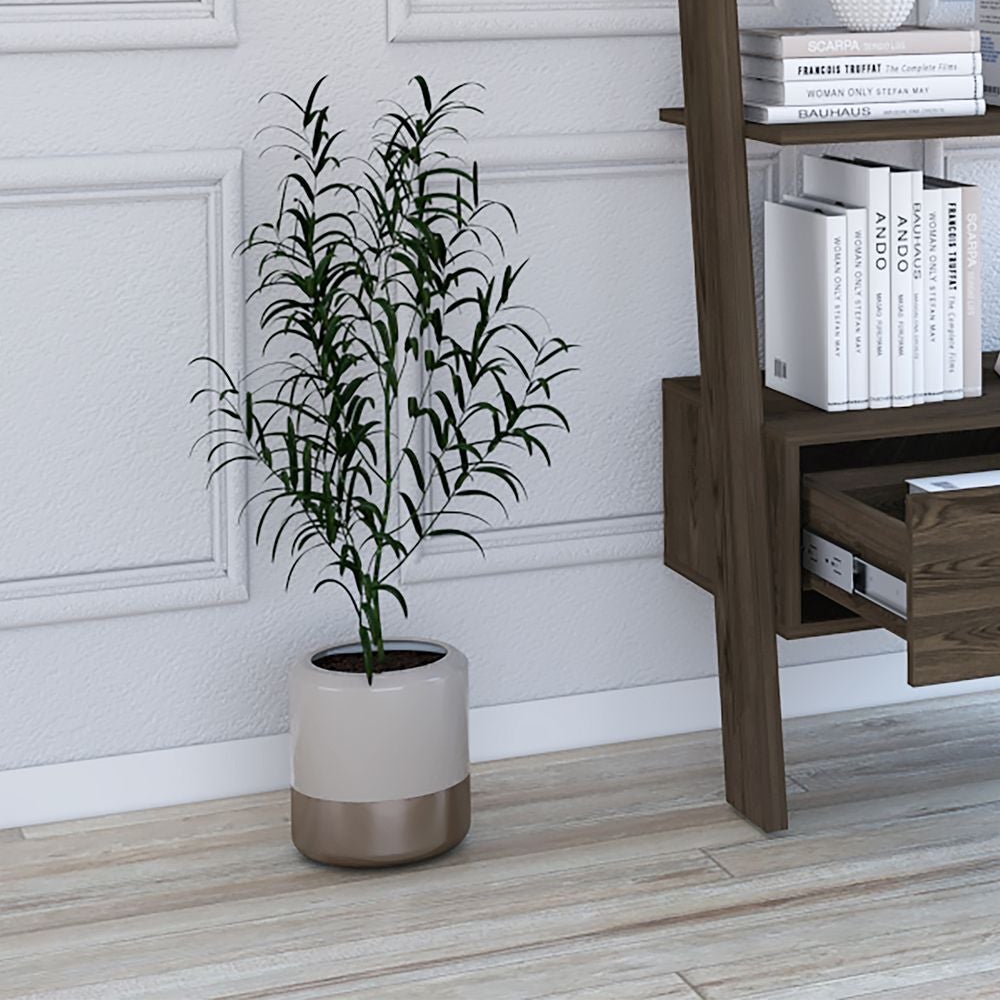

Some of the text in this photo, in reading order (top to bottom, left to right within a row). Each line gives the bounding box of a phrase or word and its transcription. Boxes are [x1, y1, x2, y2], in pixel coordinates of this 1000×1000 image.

[807, 39, 860, 53] SCARPA
[798, 62, 958, 75] FRANCOIS TRUFFAT The Complete Films
[806, 86, 929, 98] WOMAN ONLY STEFAN MAY
[798, 106, 871, 119] BAUHAUS
[876, 212, 887, 270] ANDO
[913, 202, 921, 279] BAUHAUS
[948, 202, 957, 247] FRANCOIS
[967, 213, 977, 268] SCARPA
[854, 230, 862, 267] WOMAN
[897, 215, 908, 272] ANDO
[854, 271, 862, 296] ONLY
[929, 255, 937, 281] ONLY
[948, 252, 957, 290] TRUFFAT
